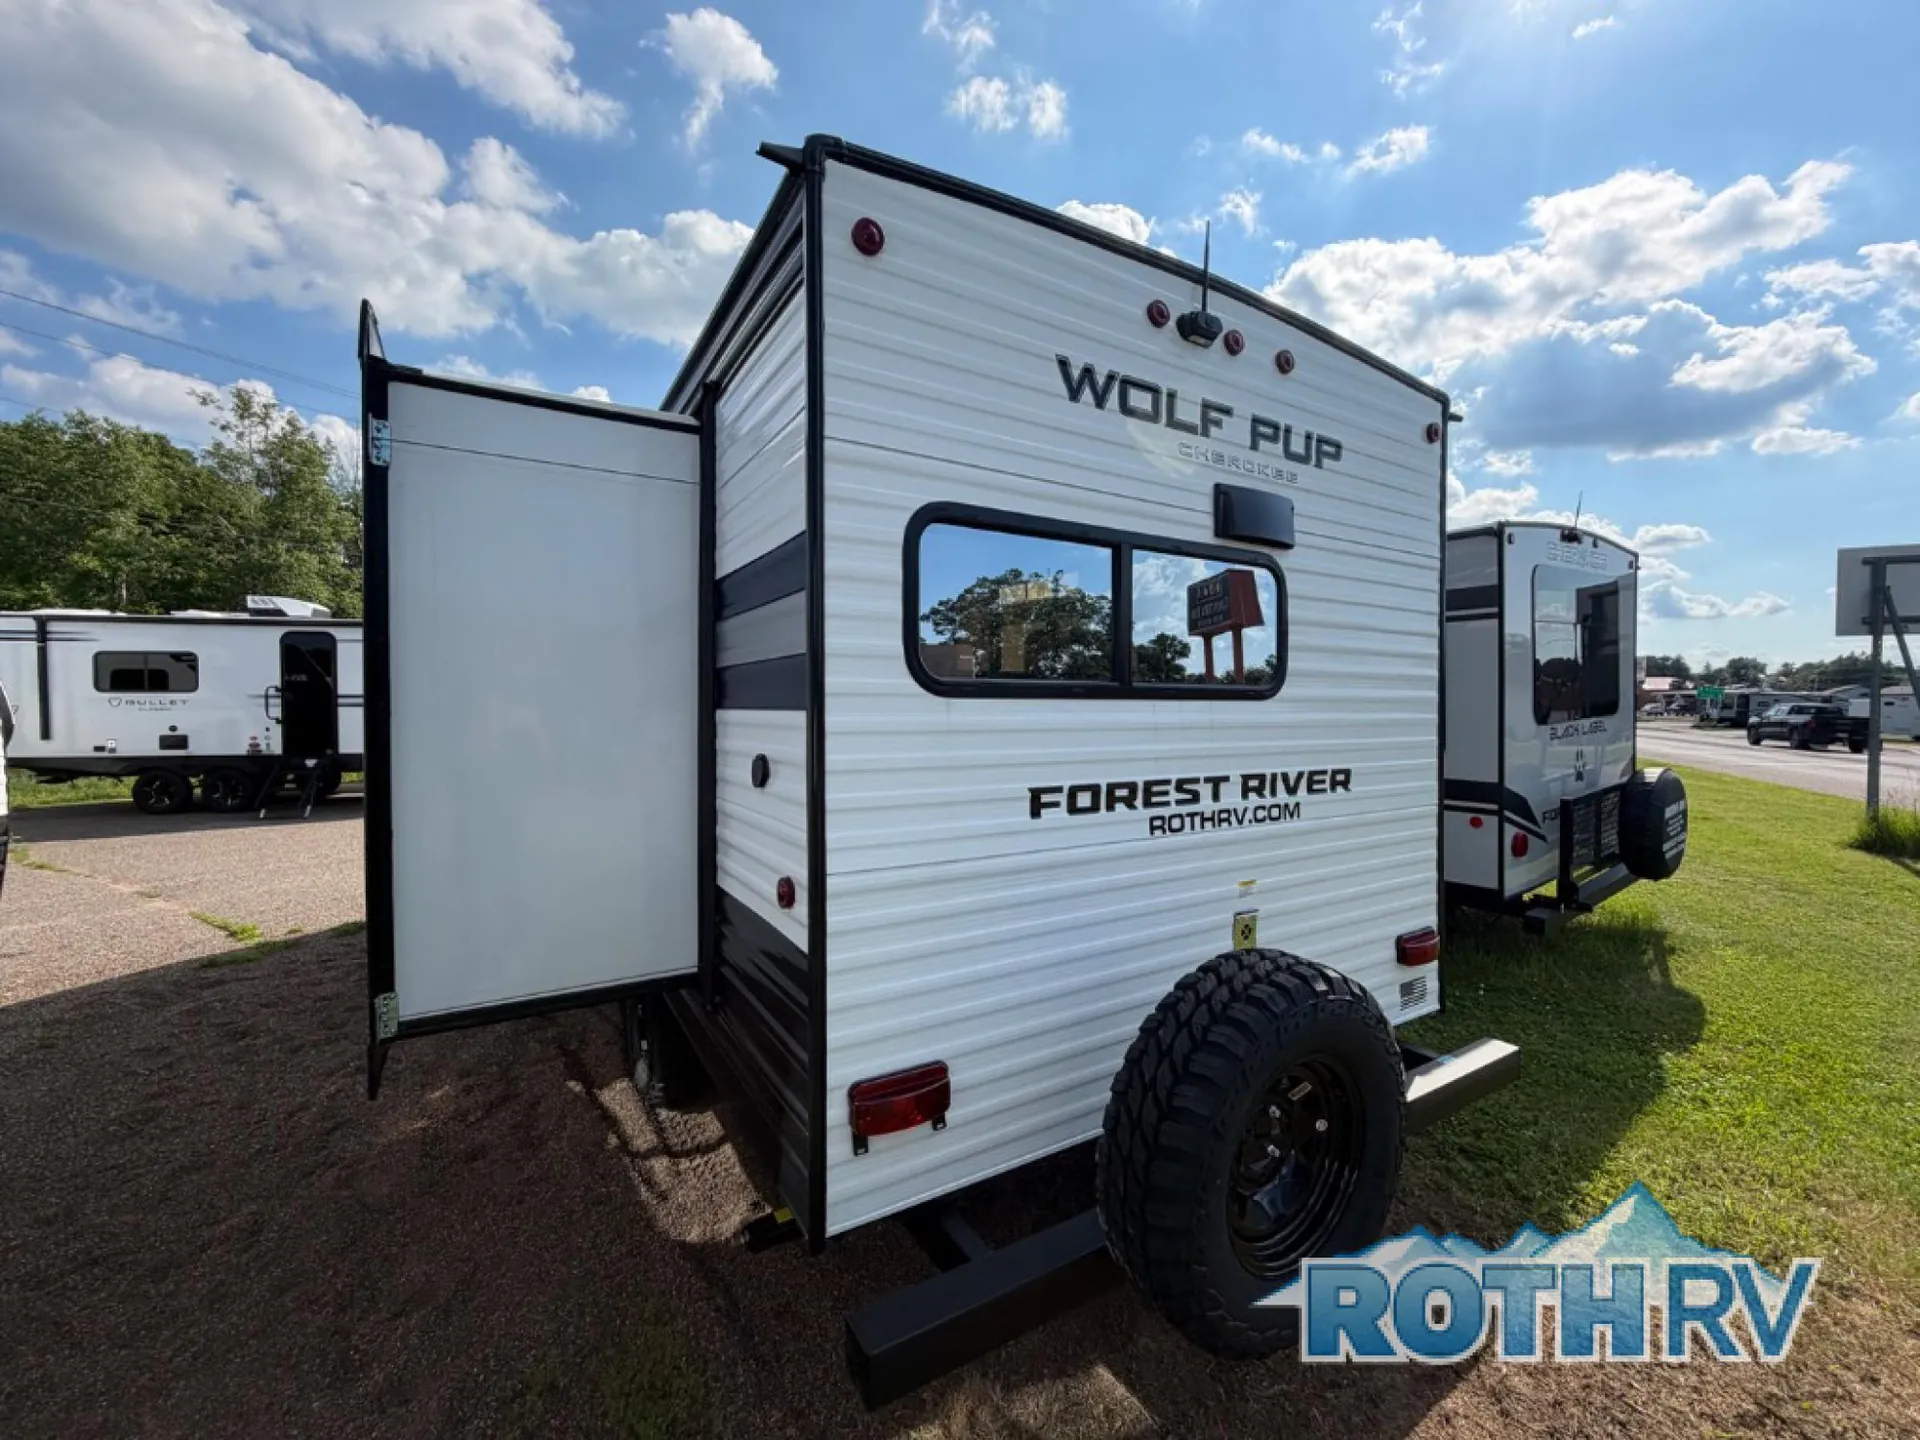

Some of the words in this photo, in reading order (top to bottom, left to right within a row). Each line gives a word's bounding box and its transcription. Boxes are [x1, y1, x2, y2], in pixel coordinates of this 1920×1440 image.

[1055, 354, 1235, 439] WOLF
[1249, 413, 1343, 469] PUP
[1178, 442, 1299, 485] CHEROKEE
[1027, 775, 1231, 820] FOREST
[1239, 768, 1353, 802] RIVER
[1149, 802, 1301, 837] ROTHRV.COM
